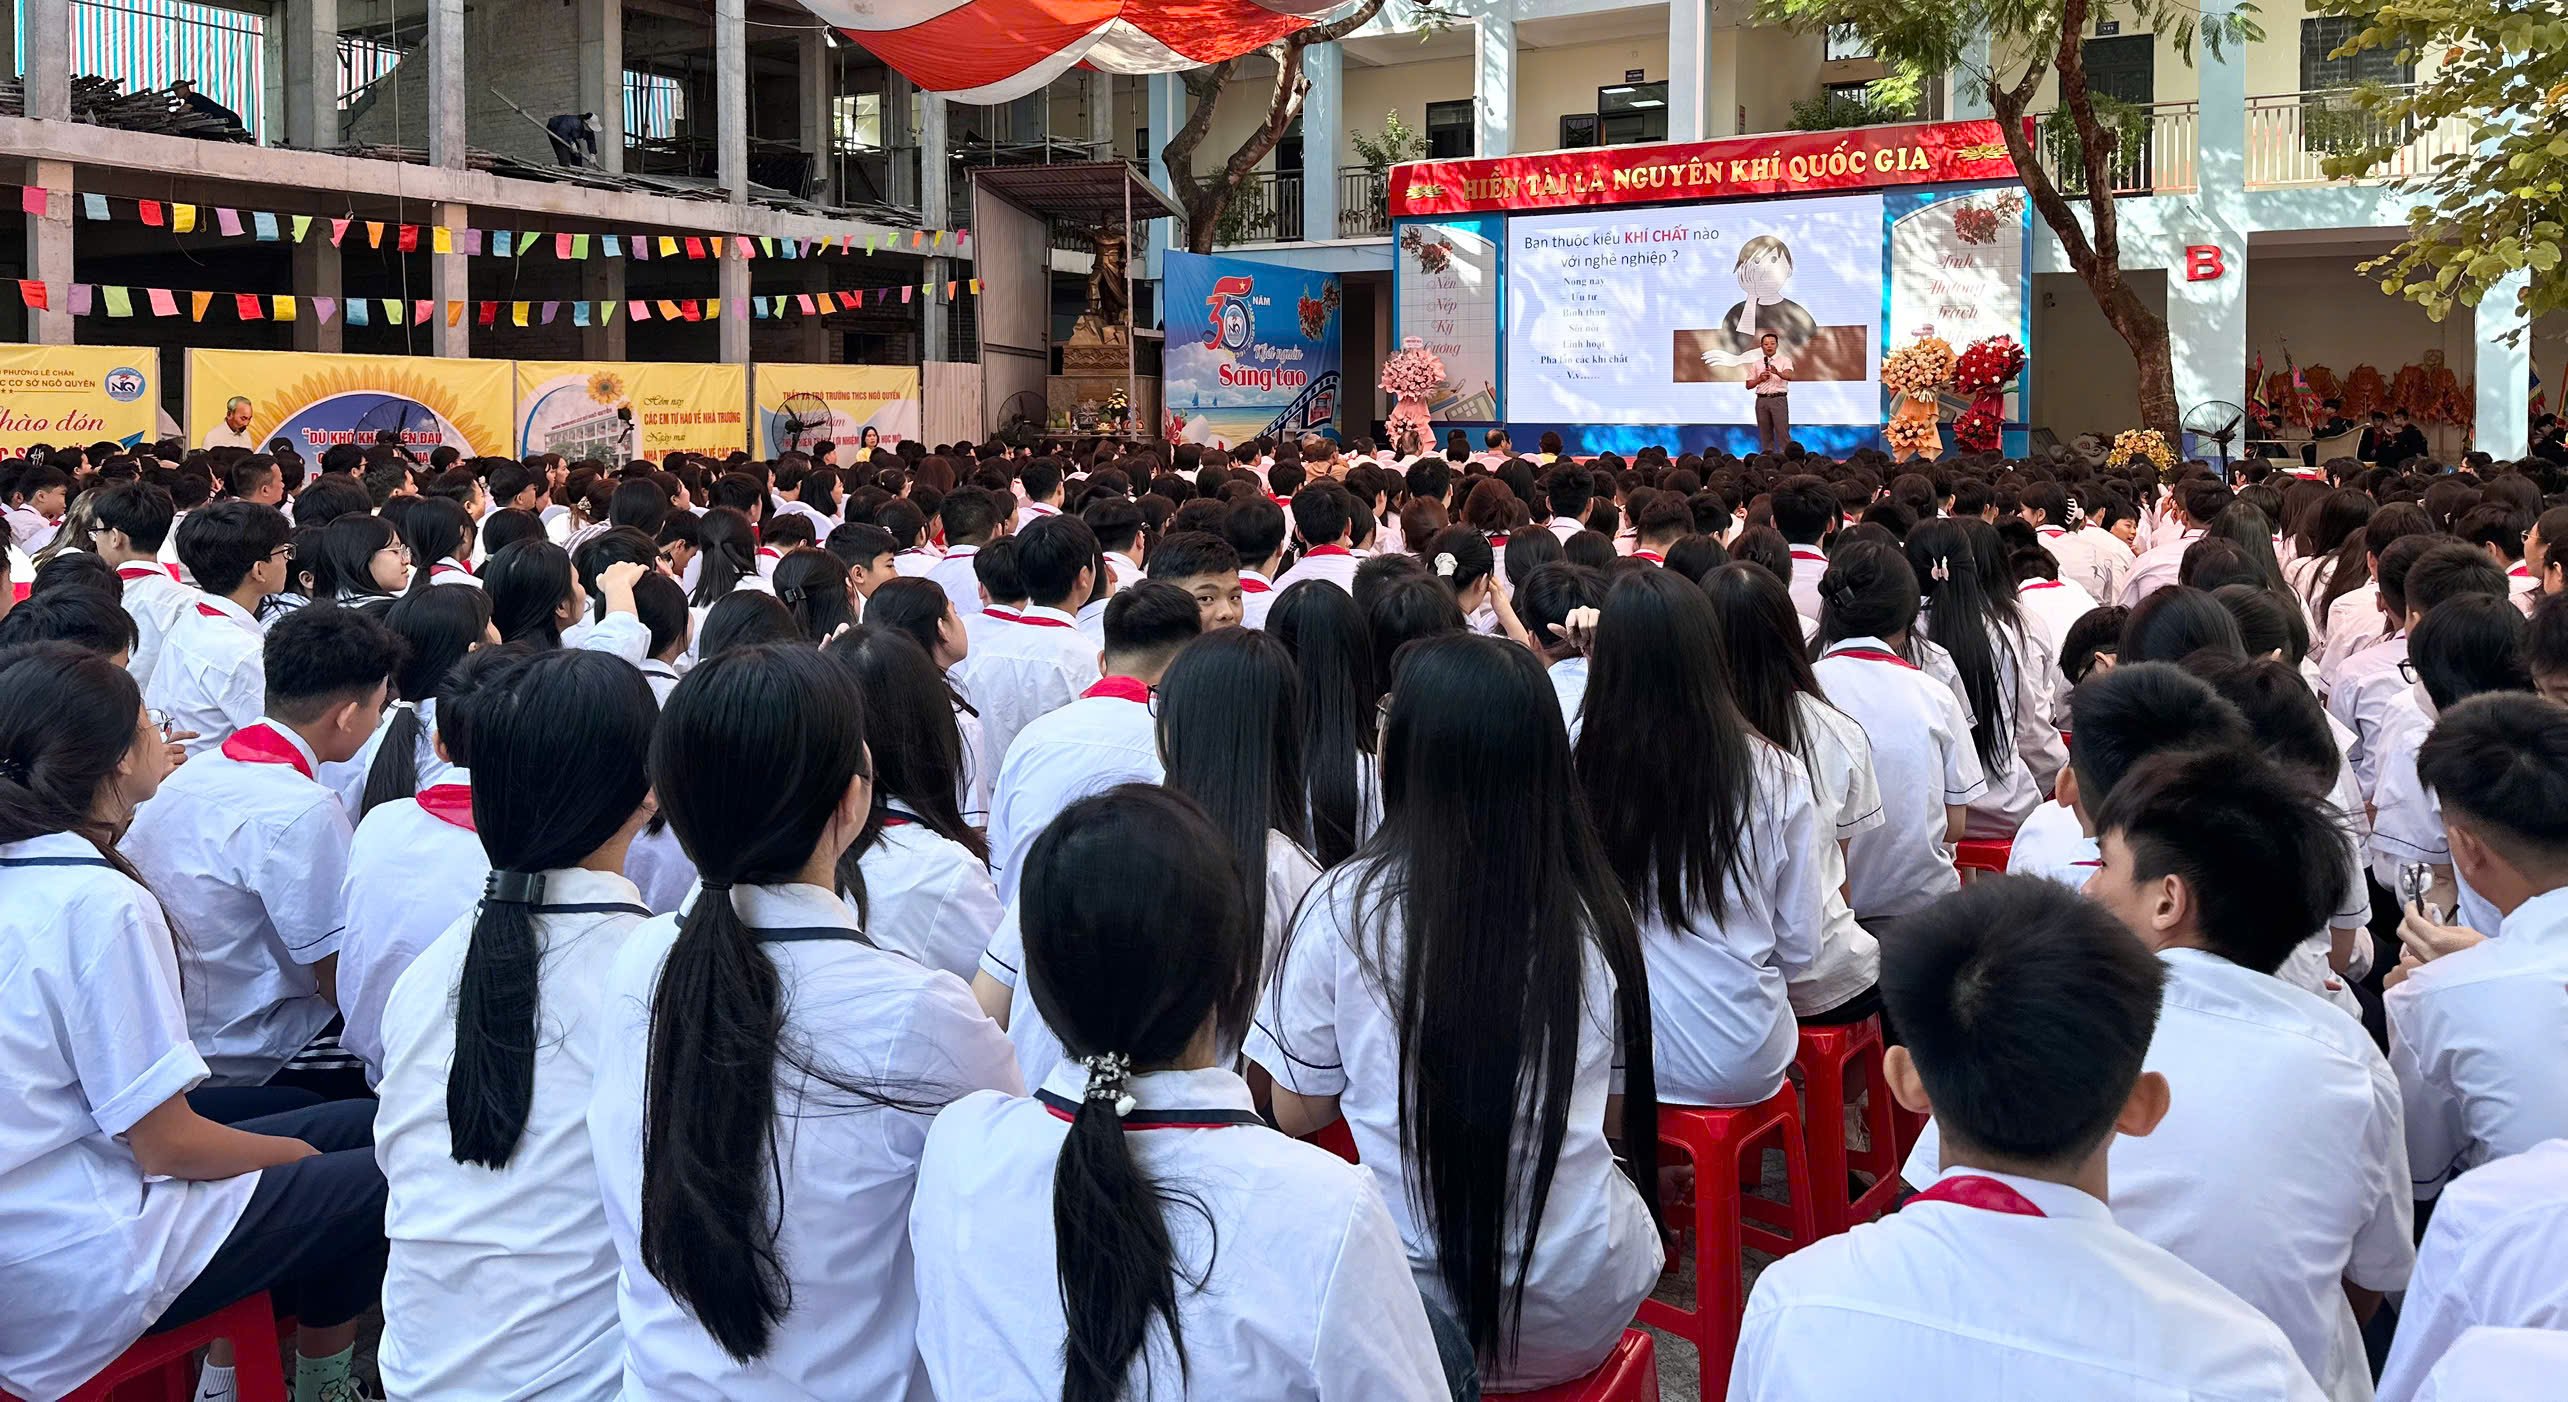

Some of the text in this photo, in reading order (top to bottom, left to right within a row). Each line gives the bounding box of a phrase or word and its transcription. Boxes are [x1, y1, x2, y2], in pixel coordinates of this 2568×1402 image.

[1463, 140, 1931, 201] HIỀN TÀI LÀ NGUYÊN KHÍ QUỐC GIA
[1525, 236, 1548, 250] Bạn
[1552, 233, 1589, 249] thuộc
[1625, 227, 1648, 243] KHÍ
[1652, 223, 1689, 242] CHẤT
[1693, 226, 1719, 240] nào
[1561, 249, 1679, 270] với nghề nghiệp ?
[2185, 244, 2224, 283] B
[1252, 295, 1271, 306] NĂM
[1540, 355, 1557, 365] Pha
[3, 368, 74, 376] PHƯỜNG LÊ CHÂN
[42, 378, 62, 387] NGÔ
[1219, 364, 1307, 392] Sáng tạo
[55, 408, 106, 432] đón
[660, 412, 669, 425] EM
